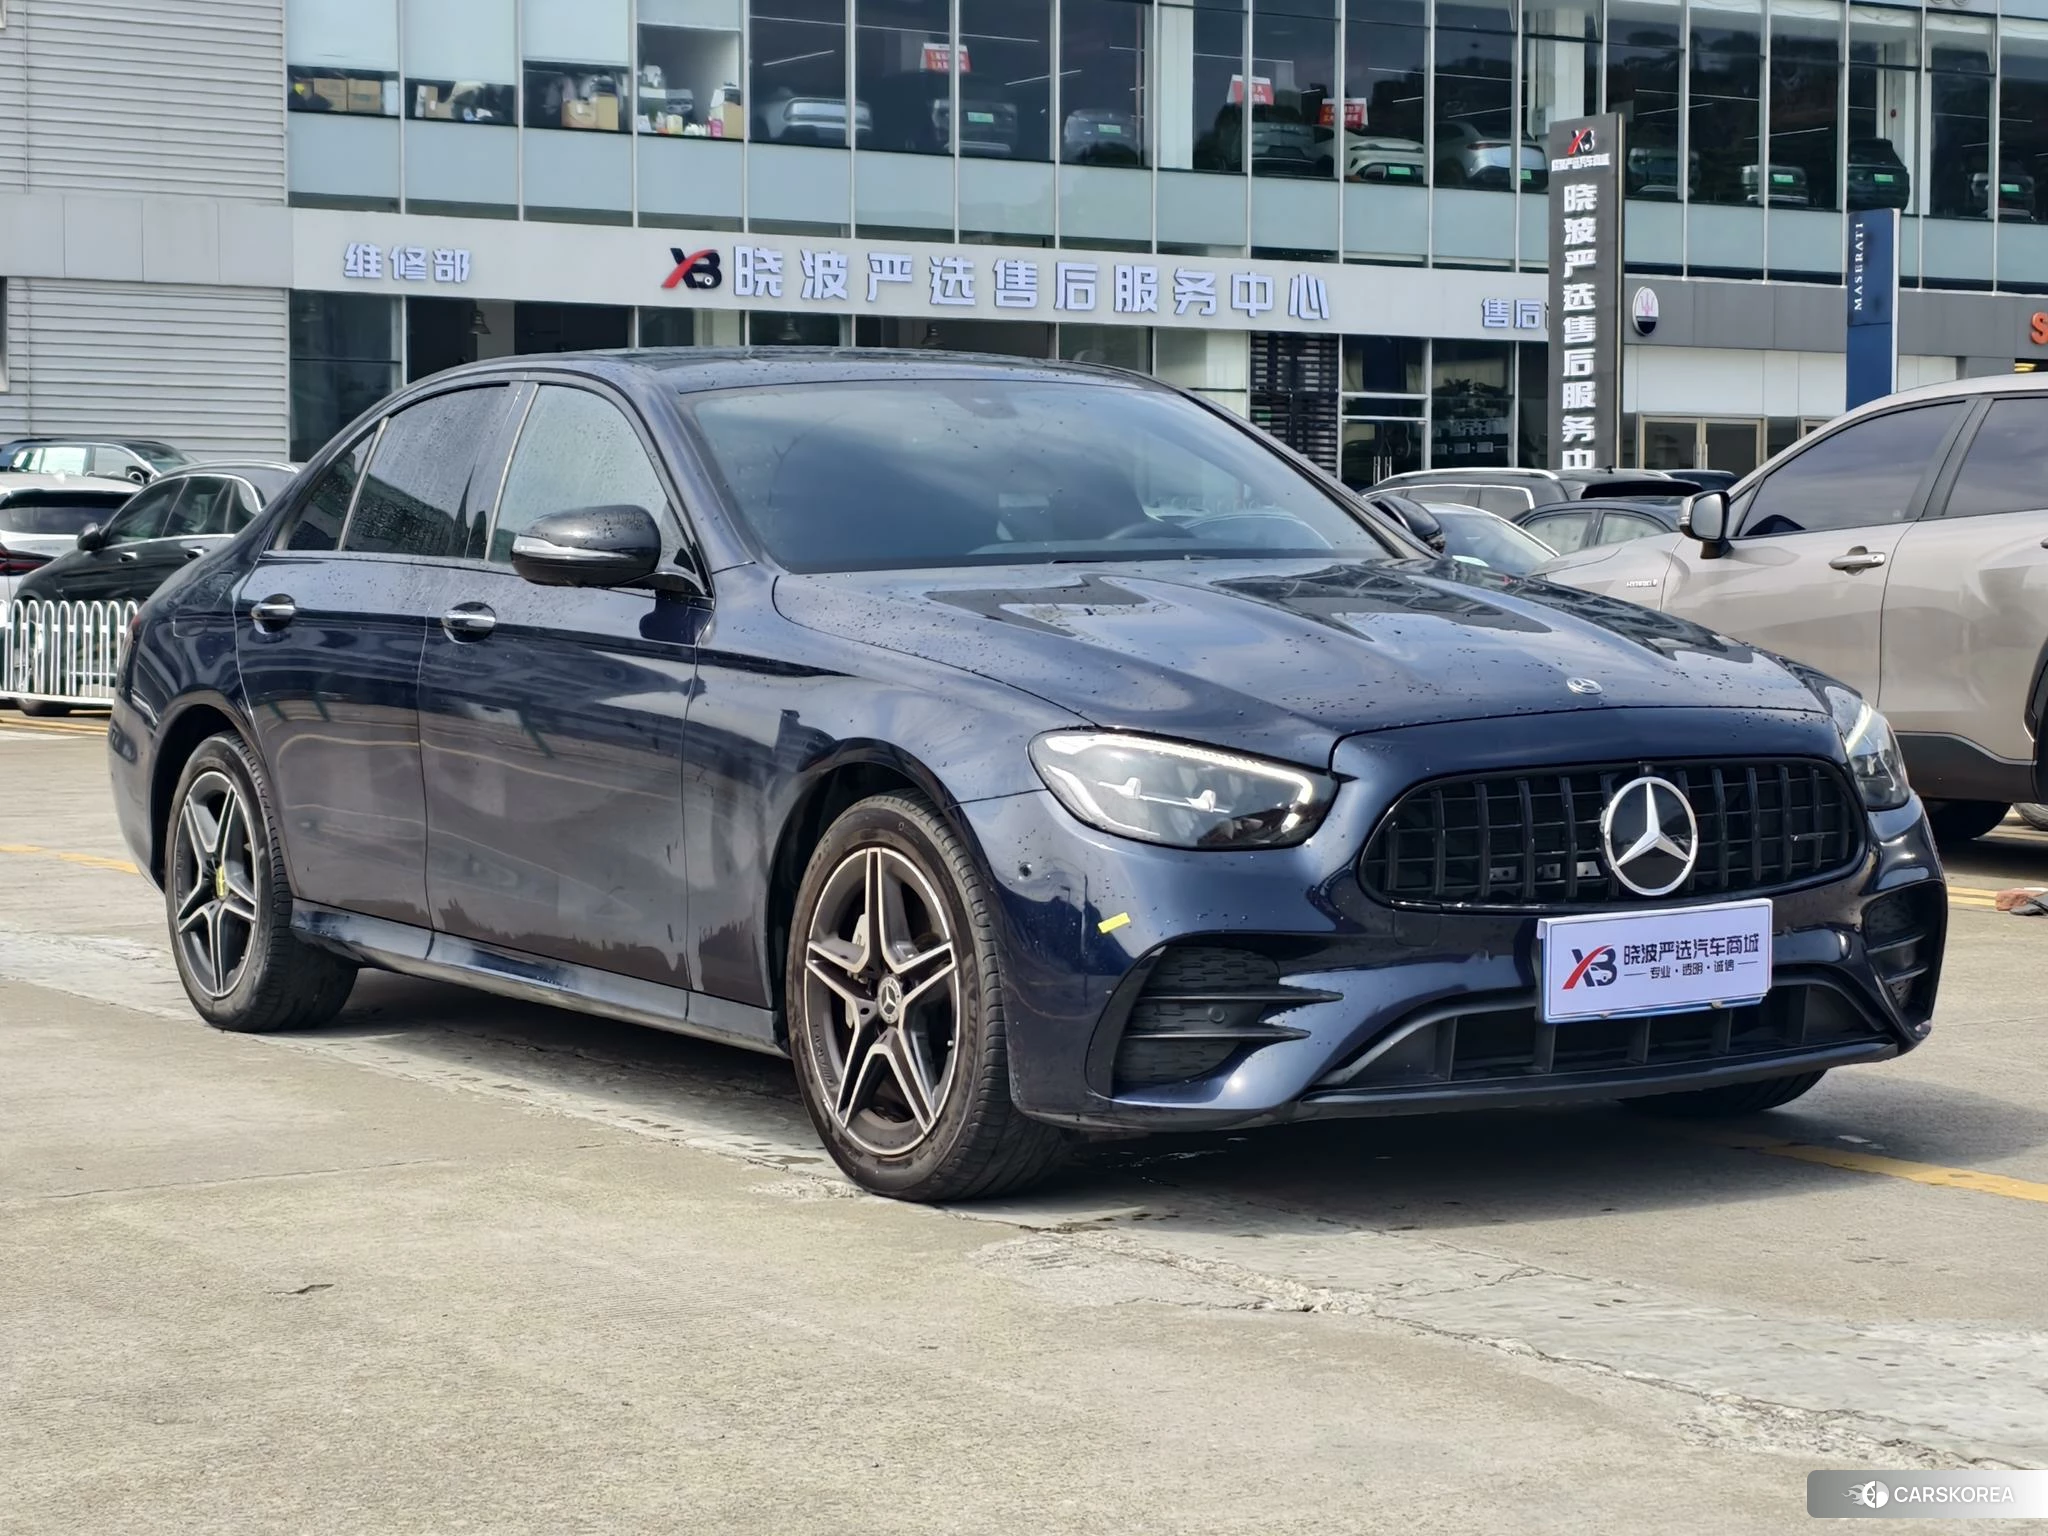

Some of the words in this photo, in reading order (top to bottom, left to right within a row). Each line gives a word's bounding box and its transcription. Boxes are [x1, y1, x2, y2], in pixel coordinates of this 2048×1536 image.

[343, 242, 470, 283] 维修部
[733, 245, 1330, 320] 晓波严选售后服务中心
[1854, 223, 1864, 311] MASERATI
[1482, 298, 1549, 329] 售后
[1623, 933, 1759, 966] 晓波严选汽车商城
